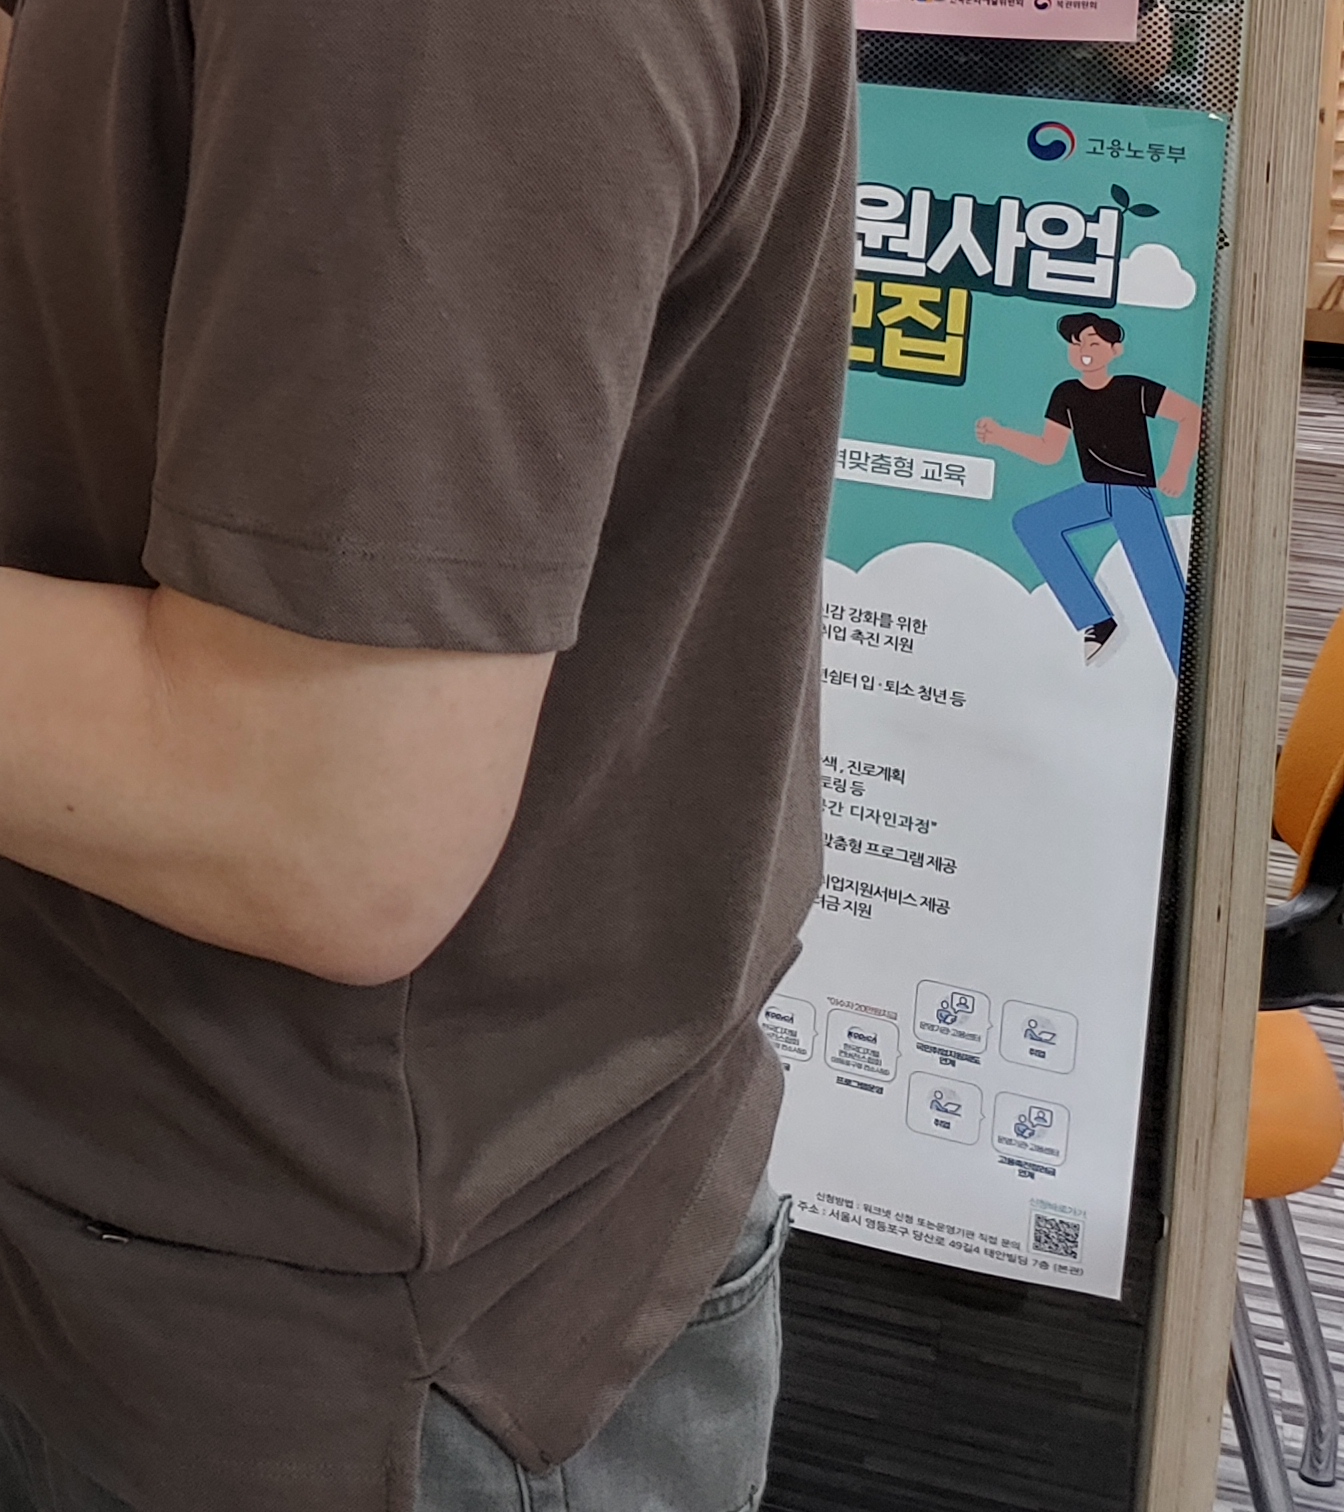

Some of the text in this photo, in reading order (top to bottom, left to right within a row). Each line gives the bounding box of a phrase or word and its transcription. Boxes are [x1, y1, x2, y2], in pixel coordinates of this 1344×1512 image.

[1085, 137, 1187, 164] 고용노동부
[854, 184, 1120, 301] 원사업
[920, 460, 966, 487] 교육
[849, 607, 894, 629] 강화를
[896, 615, 929, 635] 위한
[850, 628, 914, 654] 촉진 지원
[918, 685, 947, 705] 청년
[949, 691, 967, 708] 등
[822, 755, 905, 785] 색, 진로계획
[849, 780, 866, 797] 등
[865, 841, 925, 869] 프로그램
[926, 854, 958, 875] 제공
[823, 873, 951, 916] 업지원서비스 제공
[843, 899, 872, 920] 지원
[815, 1190, 855, 1210] 신청방법
[863, 1202, 893, 1221] 워크넷
[894, 1210, 914, 1225] 신청
[978, 1230, 999, 1245] 직접
[1000, 1236, 1021, 1251] 문의
[797, 1199, 820, 1215] 주소
[828, 1207, 863, 1227] 서울시
[864, 1216, 911, 1238] 영등포구
[912, 1227, 946, 1248] 당산로
[983, 1246, 1029, 1267] 태안빌딩
[1053, 1262, 1085, 1278] (본관)
